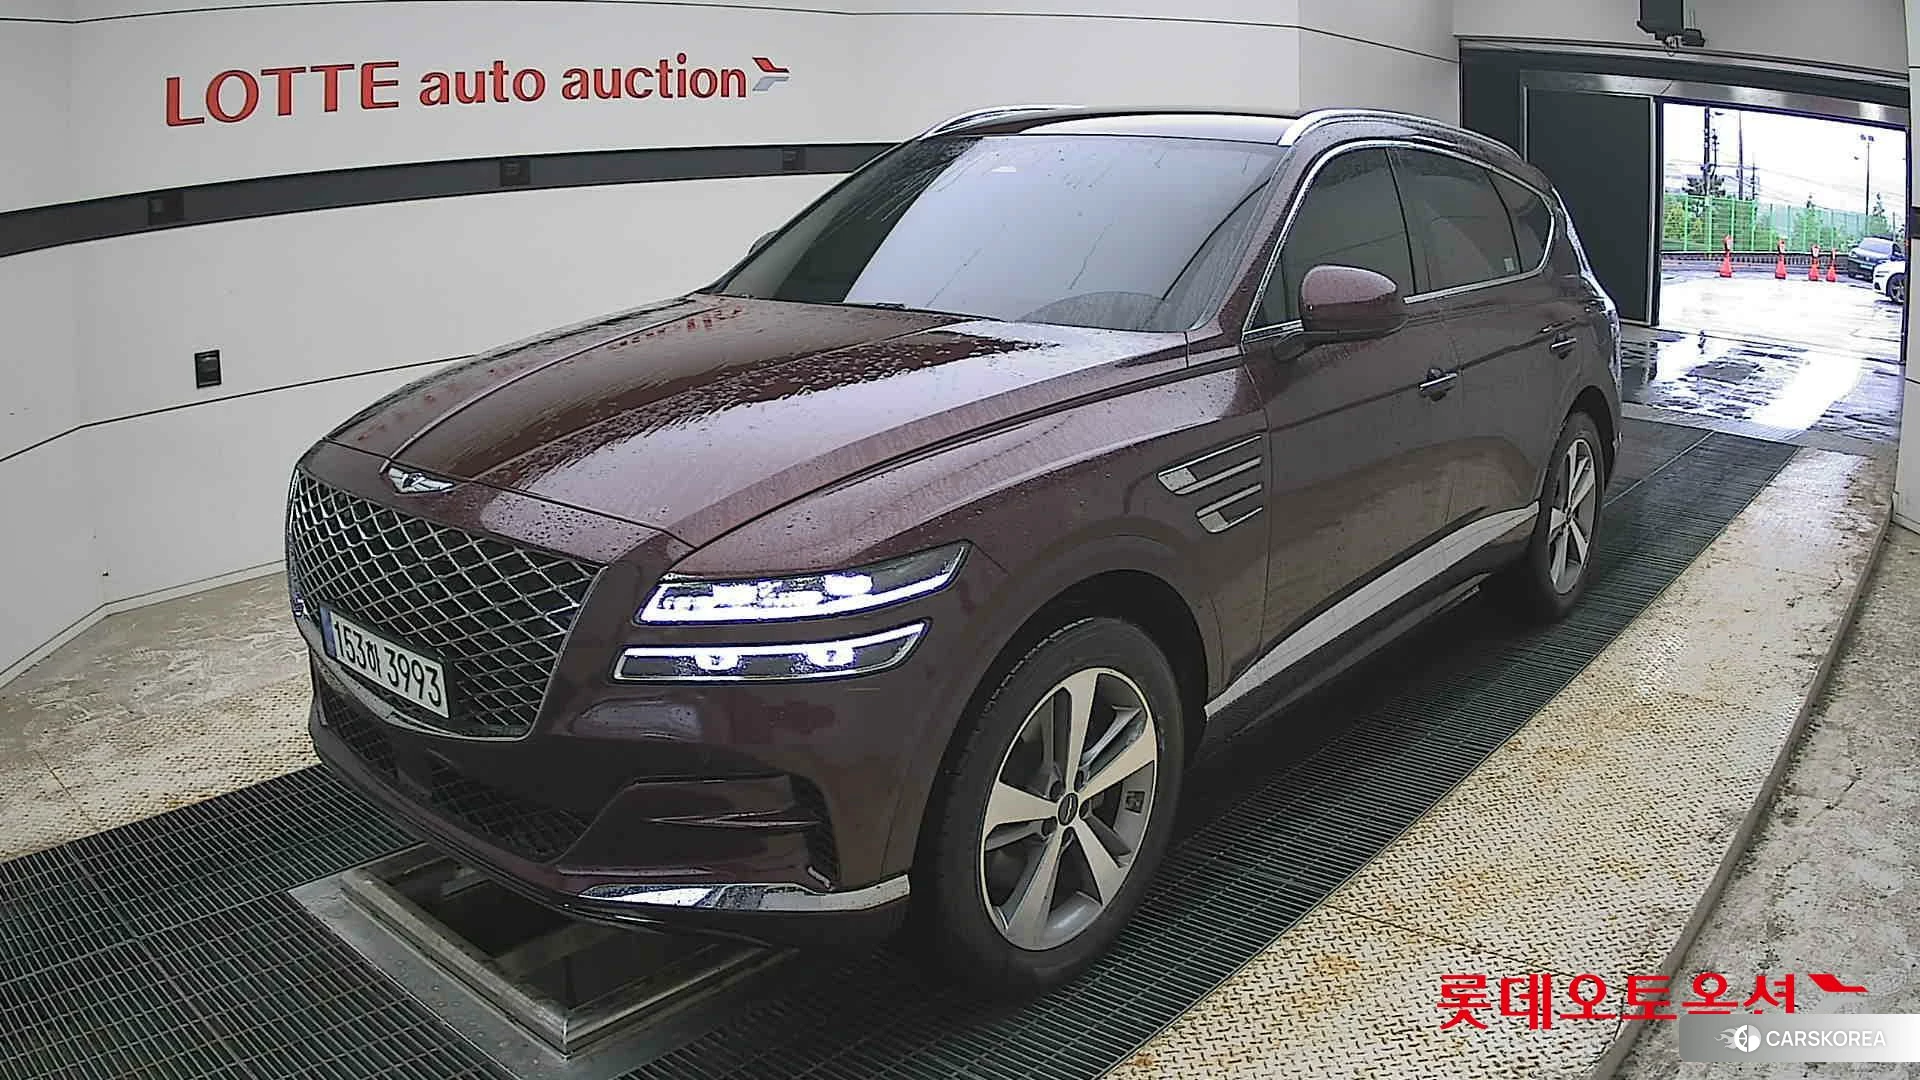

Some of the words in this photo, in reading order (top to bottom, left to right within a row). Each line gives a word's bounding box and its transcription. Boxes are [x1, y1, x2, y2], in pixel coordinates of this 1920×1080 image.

[166, 61, 400, 127] LOTTE
[419, 60, 546, 106] auto
[561, 52, 748, 99] auction
[384, 646, 442, 707] 3993
